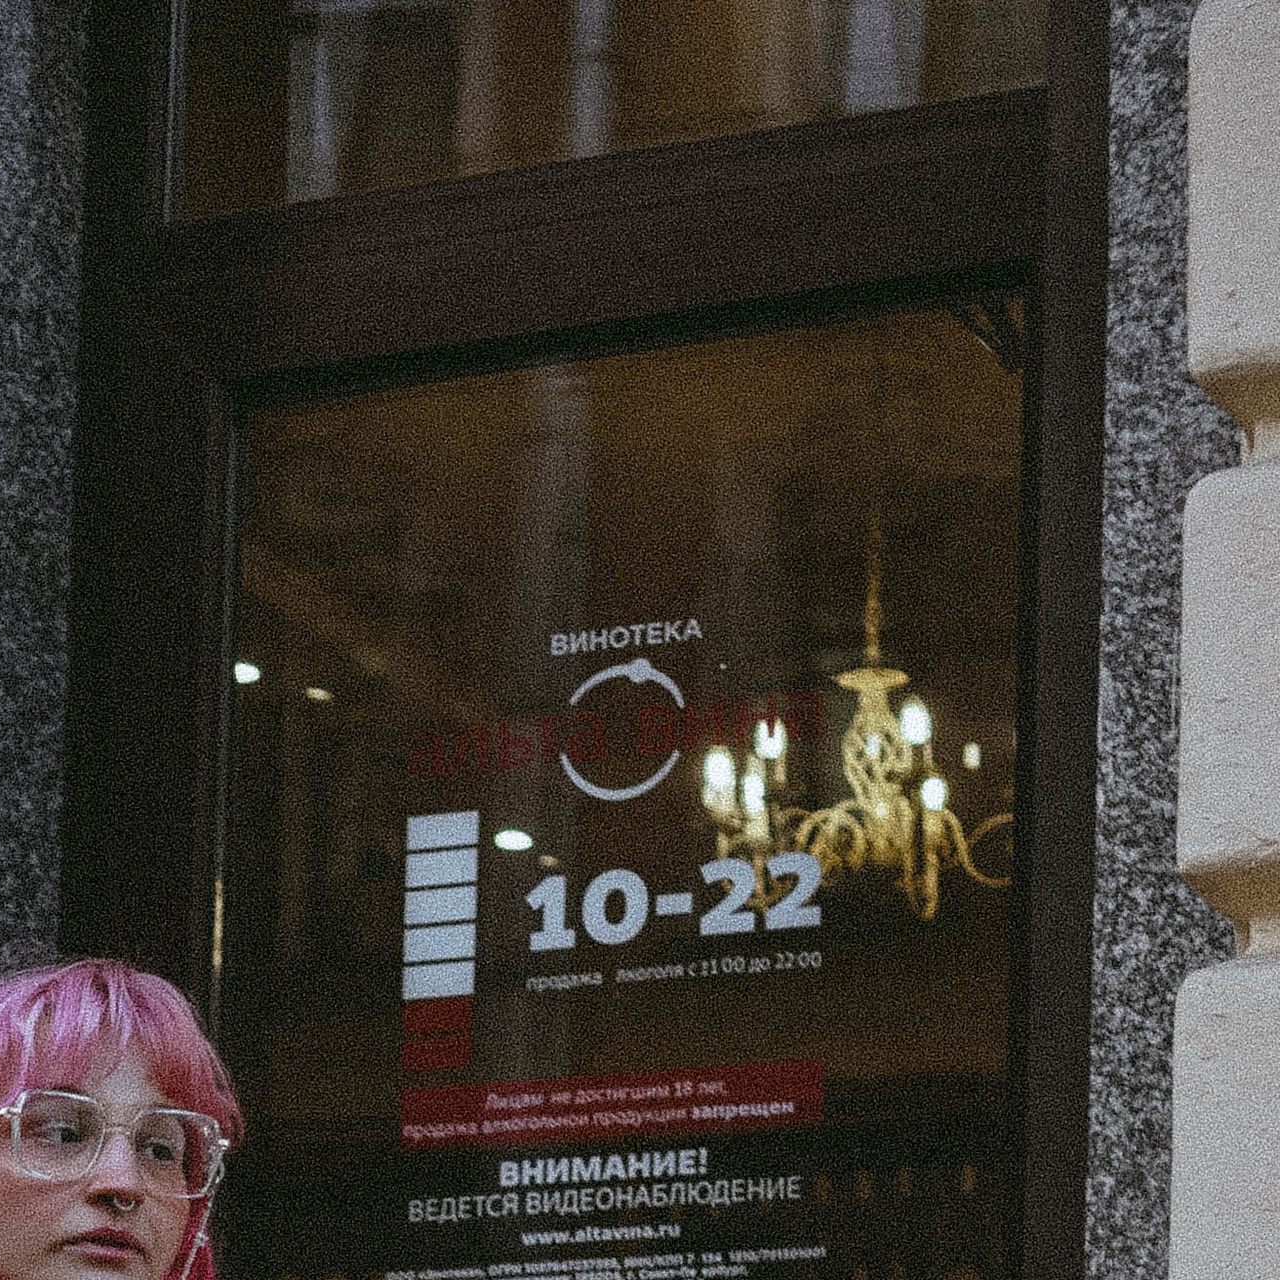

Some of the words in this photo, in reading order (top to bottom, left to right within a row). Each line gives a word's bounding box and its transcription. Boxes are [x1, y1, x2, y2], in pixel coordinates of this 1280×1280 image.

[550, 618, 703, 656] ВИНОТЕКА
[526, 851, 822, 952] 10-22
[526, 971, 603, 993] продажа
[499, 1147, 708, 1187] ВНИМАНИЕ!
[408, 1191, 519, 1224] ВЕДЕТСЯ
[526, 1174, 802, 1217] ВИДЕОНАБЛЮДЕНИЕ
[522, 1222, 681, 1247] www.altavina.ru
